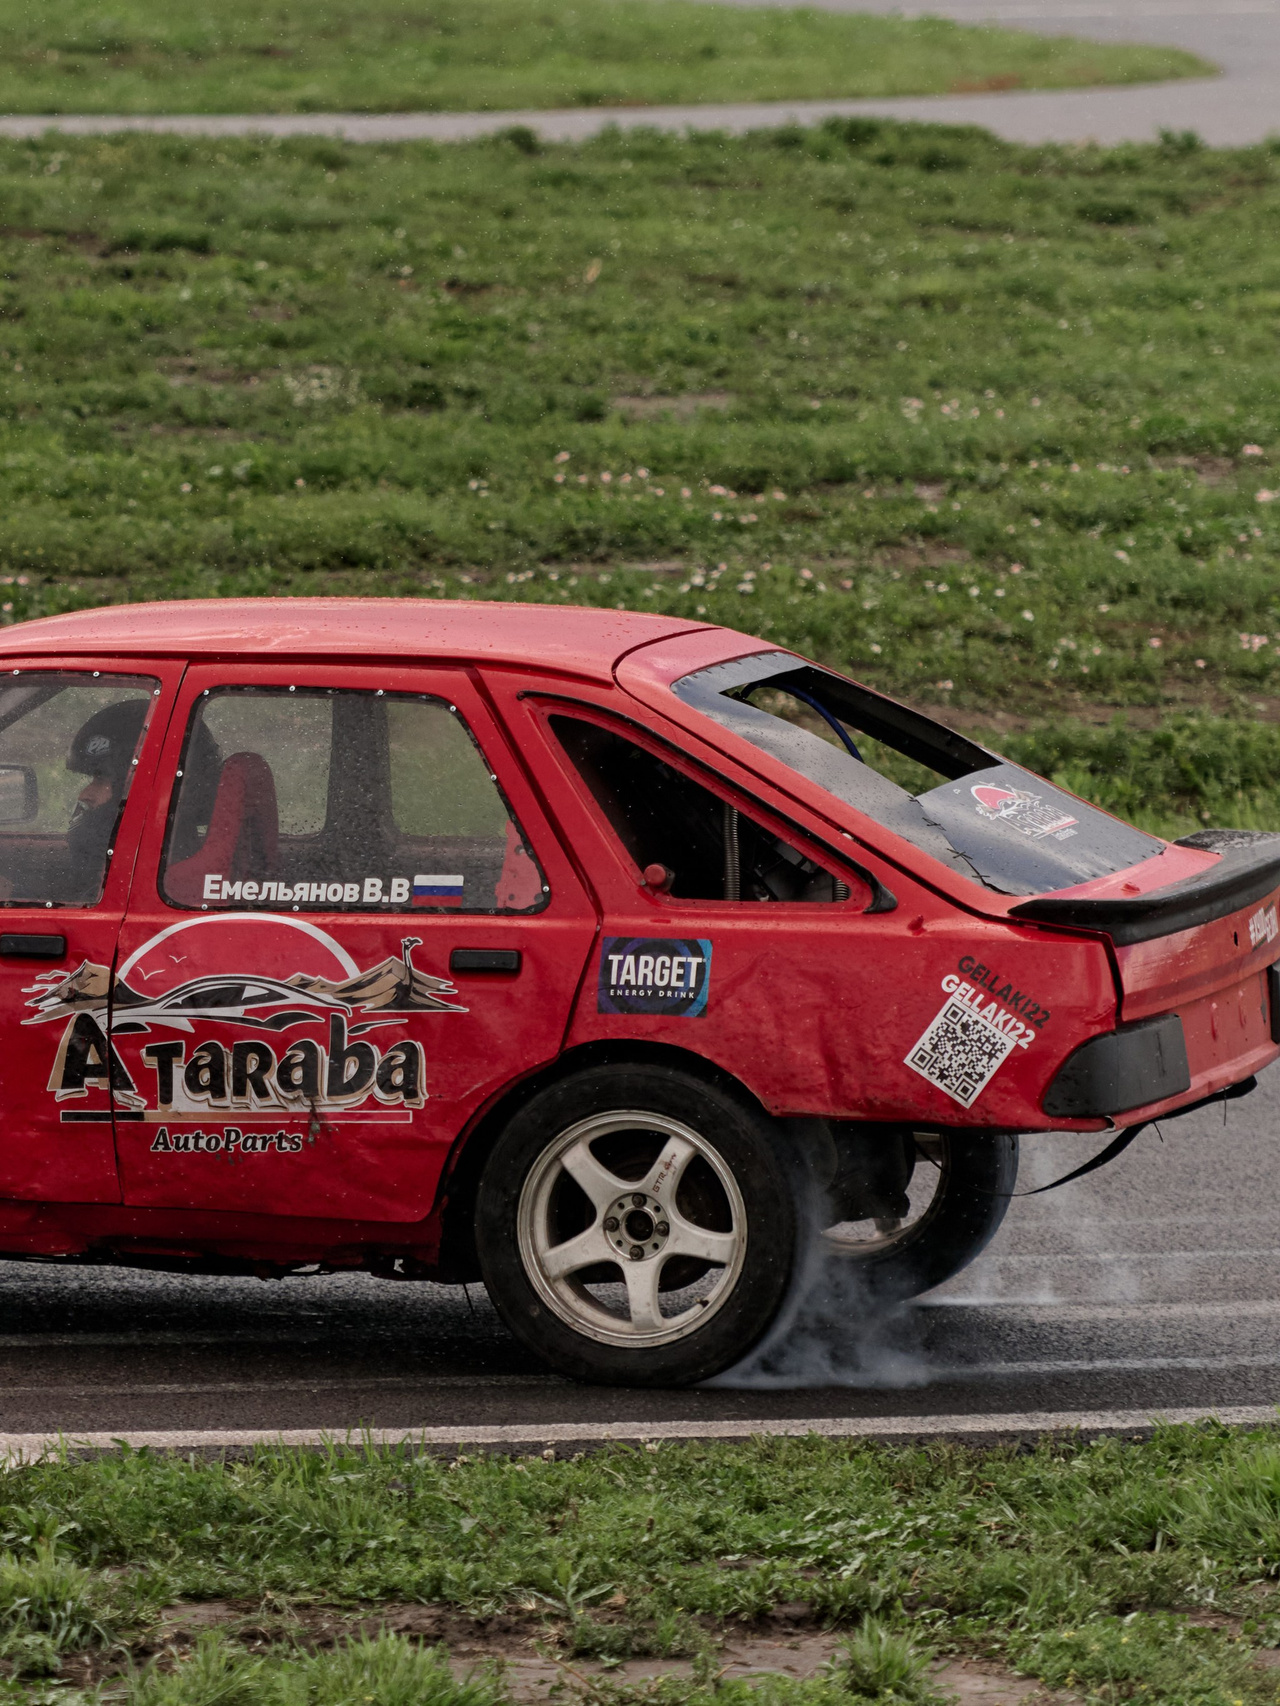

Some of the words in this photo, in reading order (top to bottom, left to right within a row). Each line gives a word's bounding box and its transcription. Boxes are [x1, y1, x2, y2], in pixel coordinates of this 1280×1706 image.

[203, 874, 360, 902] Емельянов
[608, 954, 703, 988] TARGET
[610, 989, 653, 997] ENERGY
[659, 990, 695, 999] DRINK
[958, 955, 1051, 1029] GELLAKI22
[941, 974, 1036, 1050] GELLAKI22
[151, 1127, 304, 1153] AutoParts
